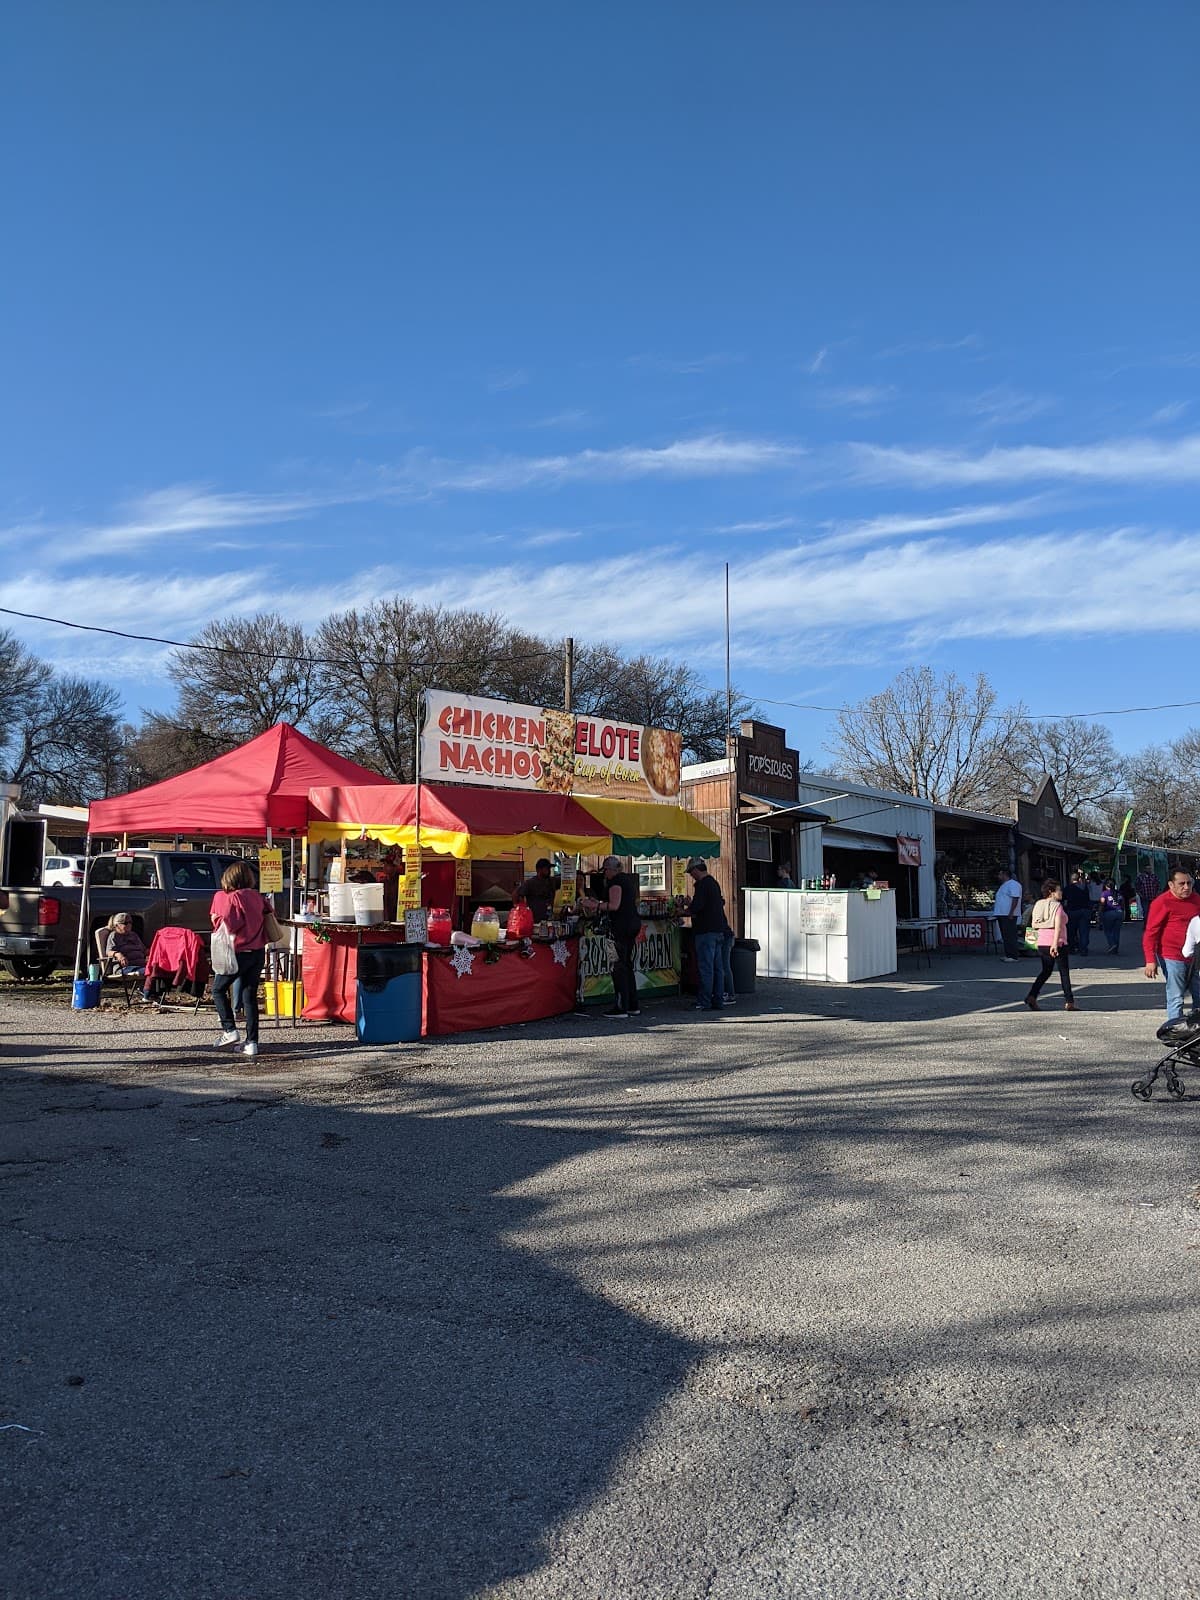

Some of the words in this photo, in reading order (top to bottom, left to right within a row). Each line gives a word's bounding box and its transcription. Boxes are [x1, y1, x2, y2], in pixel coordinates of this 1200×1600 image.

[439, 706, 546, 748] CHICKEN
[575, 721, 640, 762] ELOTE
[440, 740, 543, 780] NACHOS
[574, 758, 597, 782] Cup
[600, 761, 613, 786] of
[615, 763, 641, 783] Corn
[638, 931, 673, 970] CORN
[944, 923, 982, 939] KNIVES
